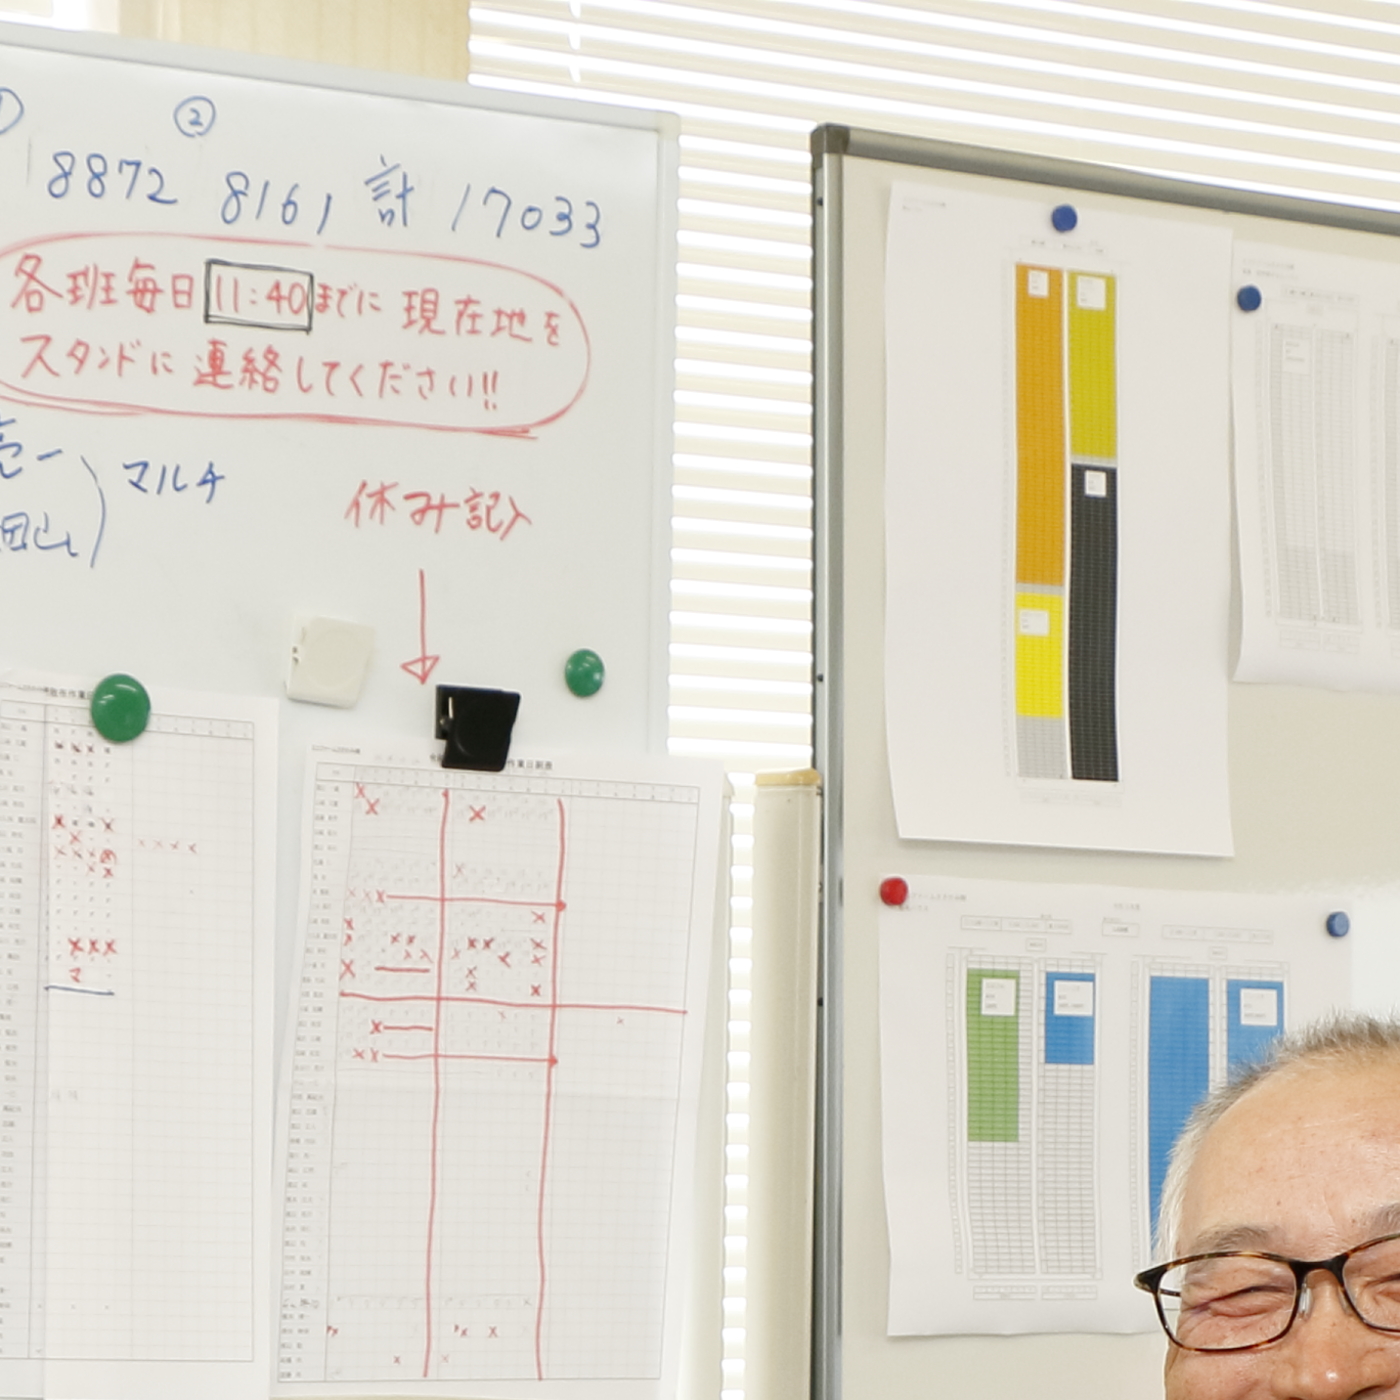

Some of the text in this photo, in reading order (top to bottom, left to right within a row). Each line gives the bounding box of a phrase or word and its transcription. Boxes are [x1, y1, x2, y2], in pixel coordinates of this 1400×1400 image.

[364, 154, 414, 227] 計
[452, 183, 601, 249] 17033
[122, 461, 226, 504] マルチ
[345, 479, 533, 541] 休み記入
